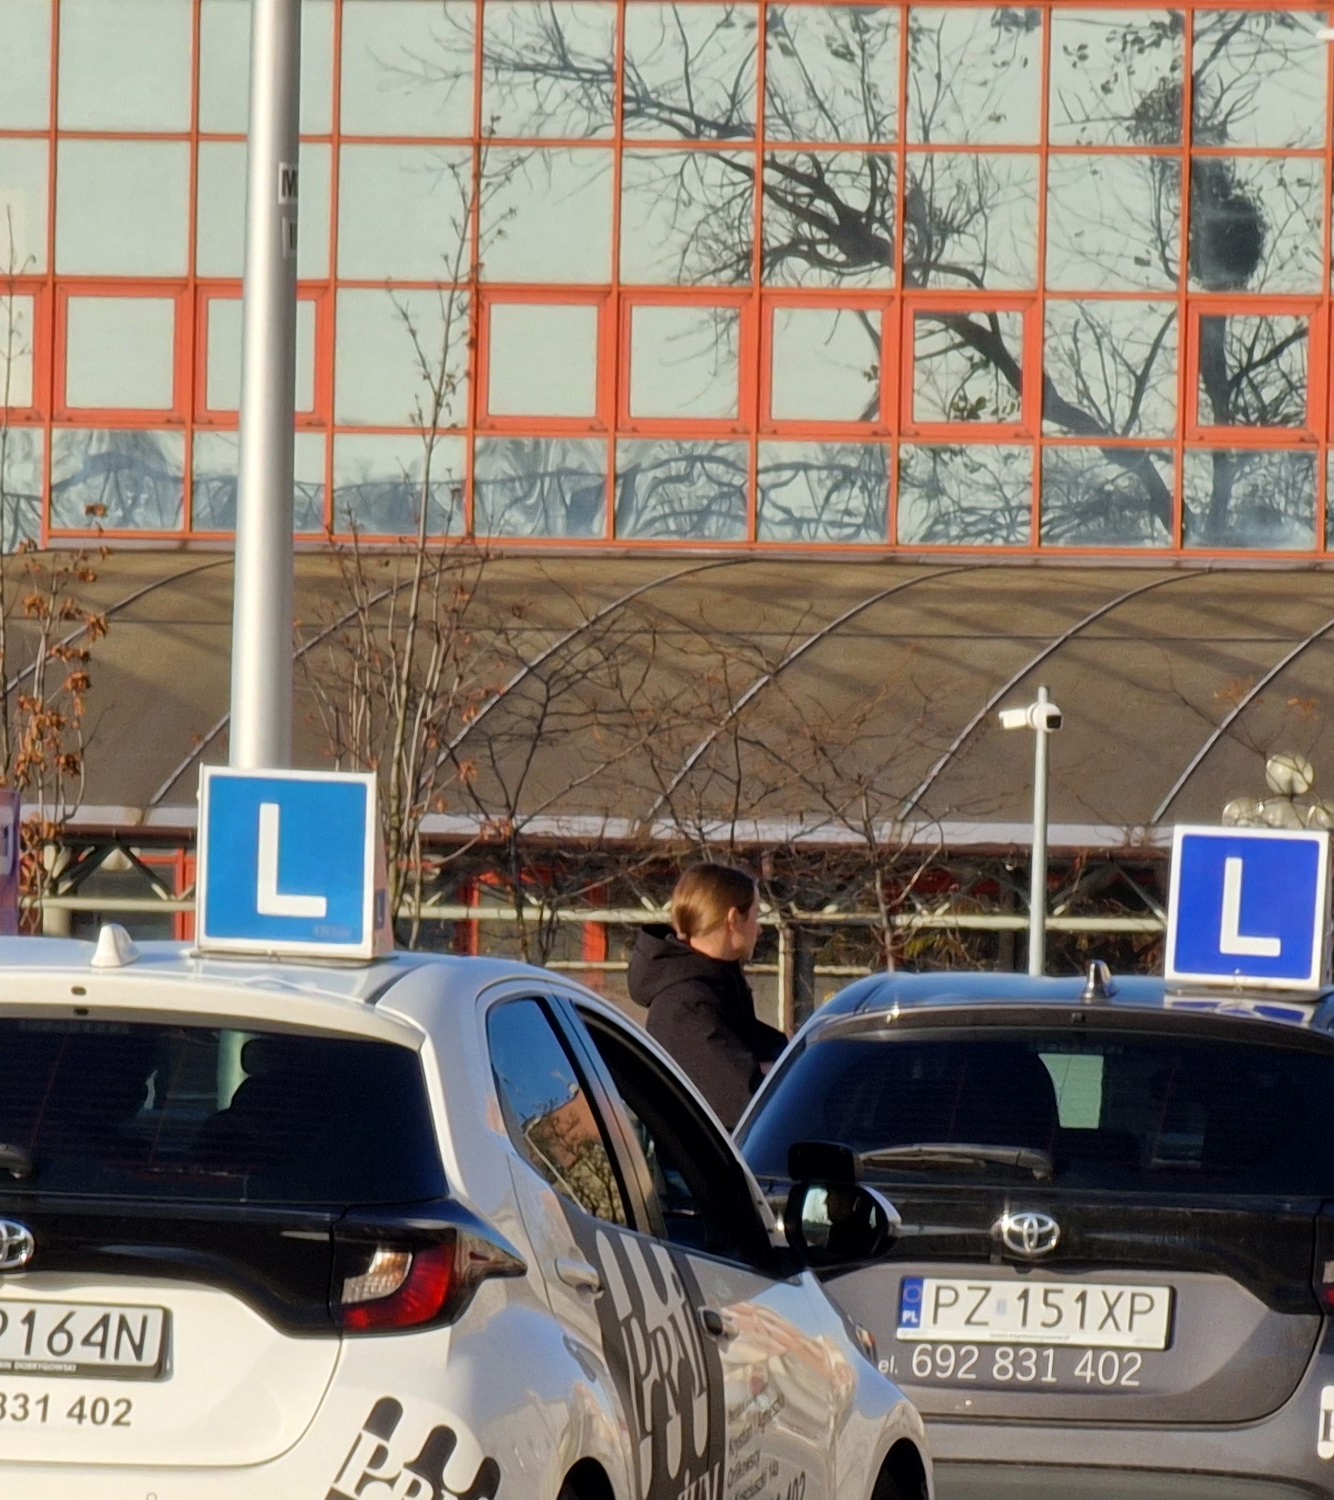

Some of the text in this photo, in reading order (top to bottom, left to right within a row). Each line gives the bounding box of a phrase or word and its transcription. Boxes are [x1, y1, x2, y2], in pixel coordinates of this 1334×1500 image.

[257, 802, 327, 918] L
[1219, 857, 1281, 957] L
[932, 1285, 1155, 1332] PZ 151XP
[878, 1343, 1143, 1387] el. 692 831 402
[66, 1395, 133, 1427] 402
